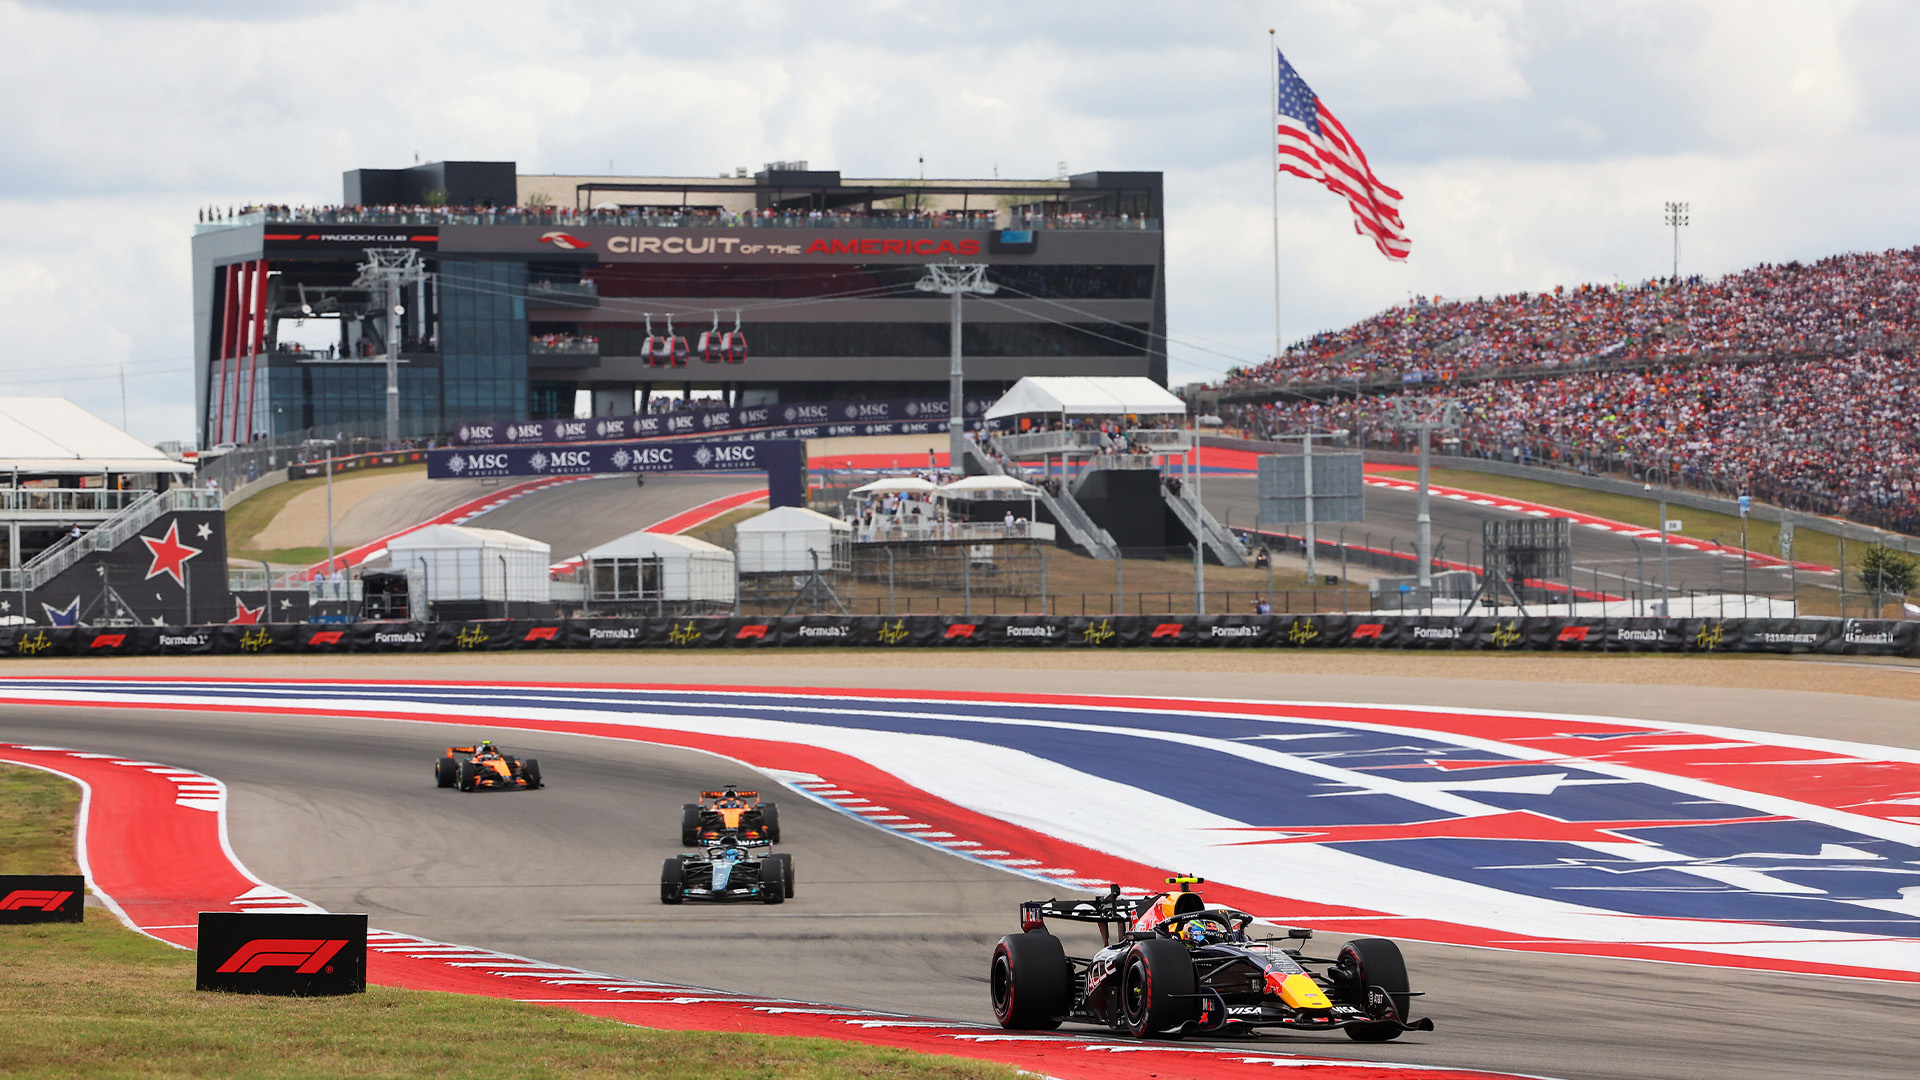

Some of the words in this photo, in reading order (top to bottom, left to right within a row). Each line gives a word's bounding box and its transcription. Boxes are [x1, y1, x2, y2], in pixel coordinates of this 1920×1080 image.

[607, 236, 740, 254] CIRCUIT
[740, 244, 762, 255] OF
[767, 244, 802, 255] THE
[806, 239, 980, 255] AMERICAS
[799, 406, 828, 418] MSC
[860, 403, 889, 416] MSC
[920, 402, 949, 413] MSC
[470, 426, 493, 439] MSC
[518, 424, 543, 438] MSC
[565, 422, 586, 436] MSC
[606, 421, 625, 434] MSC
[551, 451, 591, 467] MSC
[633, 448, 673, 464] MSC
[715, 446, 755, 462] MSC
[468, 453, 508, 470] MSC
[308, 631, 344, 645] F1
[375, 632, 415, 643] Formula
[523, 627, 559, 641] F1
[589, 628, 629, 639] Formula
[735, 625, 769, 639] F1
[799, 626, 840, 637] Formula
[944, 624, 977, 638] F1
[1007, 625, 1046, 637] Formula
[1151, 624, 1184, 638] F1
[1212, 626, 1251, 637] Formula
[1352, 624, 1385, 638] F1
[1414, 627, 1453, 638] Formula
[1556, 626, 1590, 641] F1
[1618, 628, 1656, 641] Formula
[90, 634, 126, 648] F1
[160, 635, 198, 646] Formula
[0, 890, 74, 912] F1
[216, 939, 349, 973] F1
[1227, 1007, 1262, 1015] VISA
[1331, 1006, 1361, 1014] VISA
